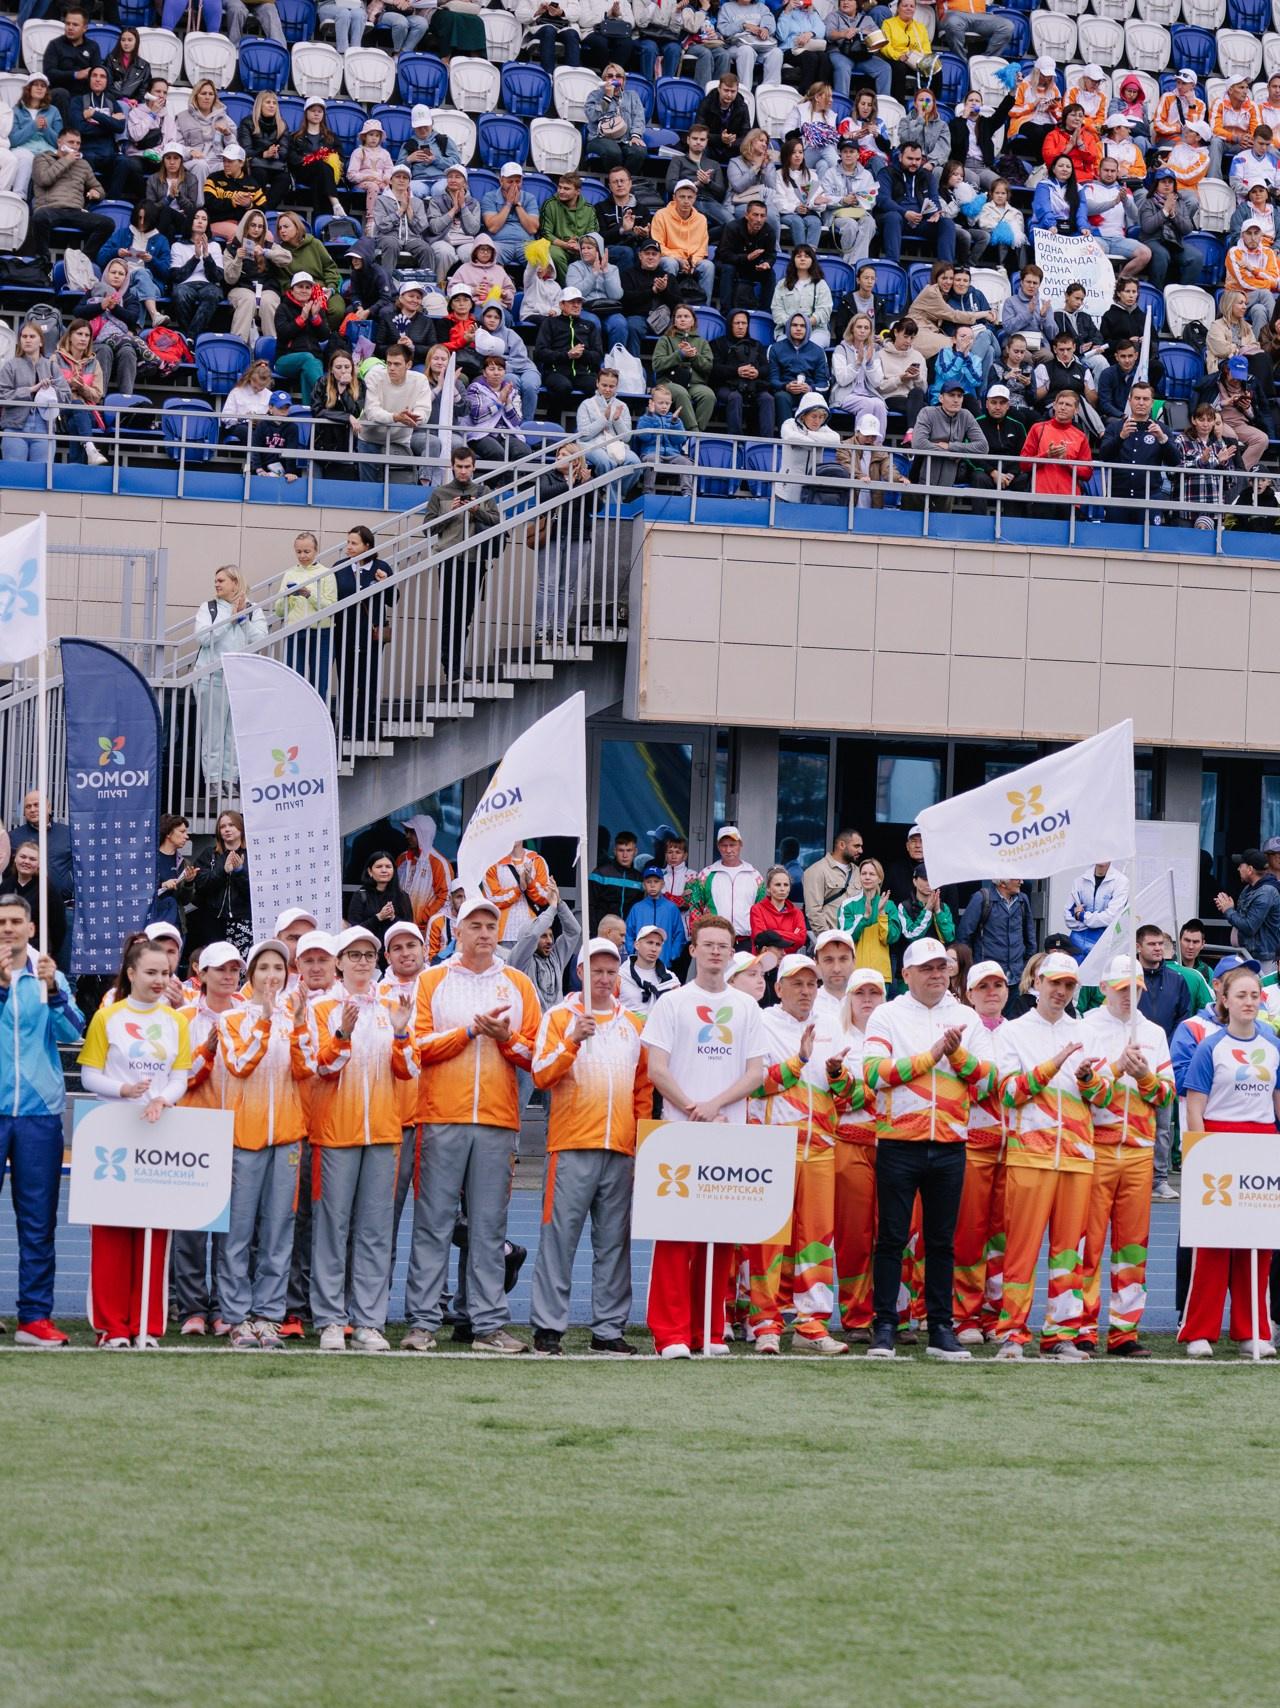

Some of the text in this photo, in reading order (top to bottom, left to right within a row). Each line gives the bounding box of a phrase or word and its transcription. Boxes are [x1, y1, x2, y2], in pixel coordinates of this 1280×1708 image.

[1034, 229, 1094, 245] ИЖМОЛОКО
[1037, 242, 1064, 255] ОДНА
[1040, 253, 1097, 265] КОМАНДА!
[1042, 264, 1072, 274] ОДНА
[1044, 277, 1092, 287] МИССИЯ!
[1043, 287, 1066, 297] ОДН
[697, 1045, 733, 1056] КОМОС
[128, 1061, 166, 1071] КОМОС
[1234, 1083, 1270, 1092] КОМОС
[134, 1149, 210, 1169] КОМОС
[133, 1167, 195, 1179] КАЗАНСКИЙ
[697, 1165, 773, 1184] КОМОС
[133, 1176, 173, 1185] МОЛОЧНЫЙ
[697, 1183, 765, 1195] УДМУРТСКАЯ
[696, 1193, 764, 1201] ПТИЦЕФАБРИКА
